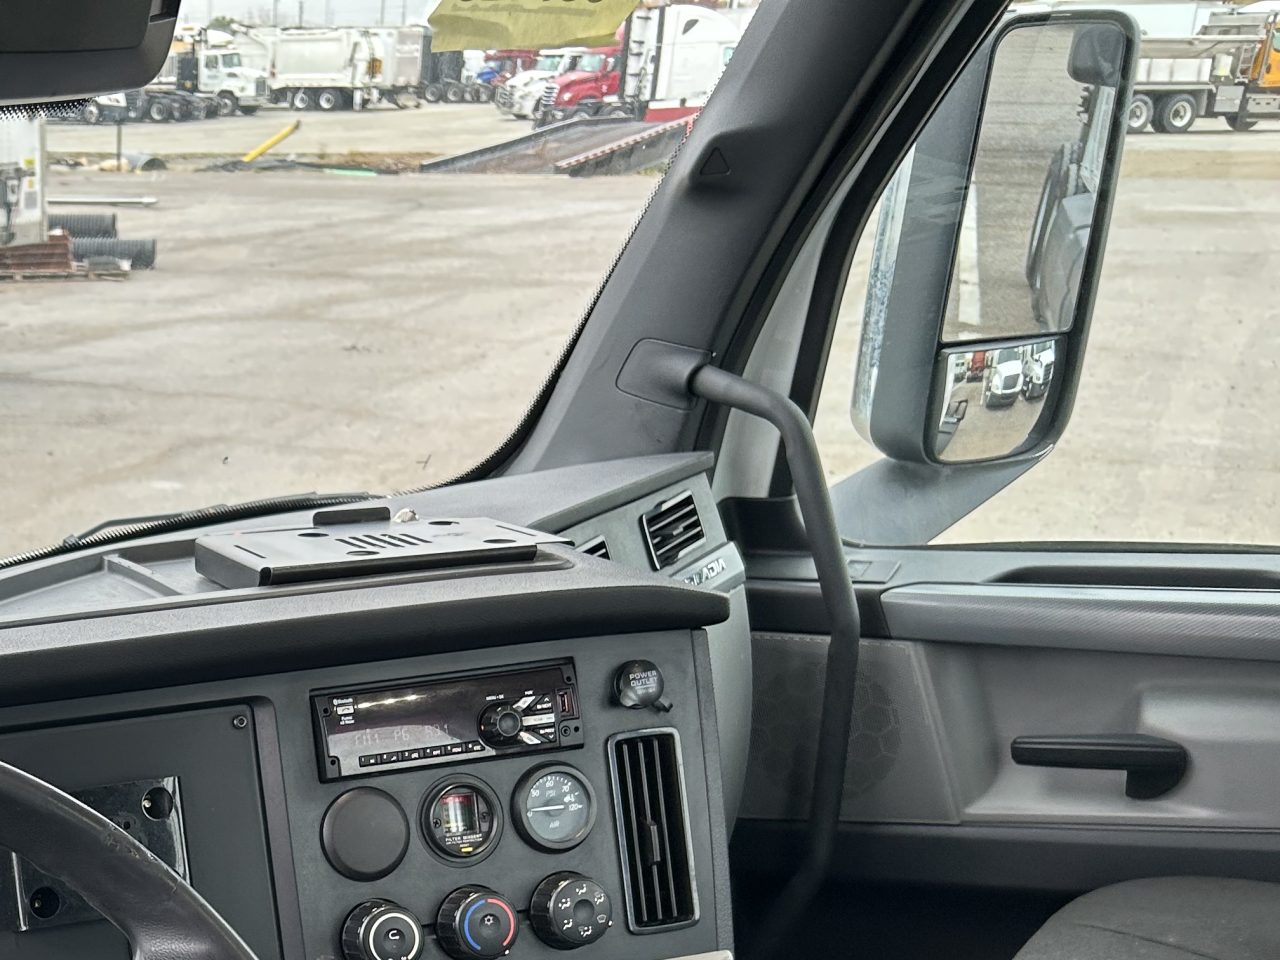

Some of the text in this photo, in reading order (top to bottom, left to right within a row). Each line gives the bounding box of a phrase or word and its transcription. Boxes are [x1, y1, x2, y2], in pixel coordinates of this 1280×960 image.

[629, 670, 657, 680] POWER
[630, 677, 658, 686] OUTLET
[546, 780, 554, 788] 60
[562, 785, 570, 793] 70
[549, 821, 560, 829] AIR
